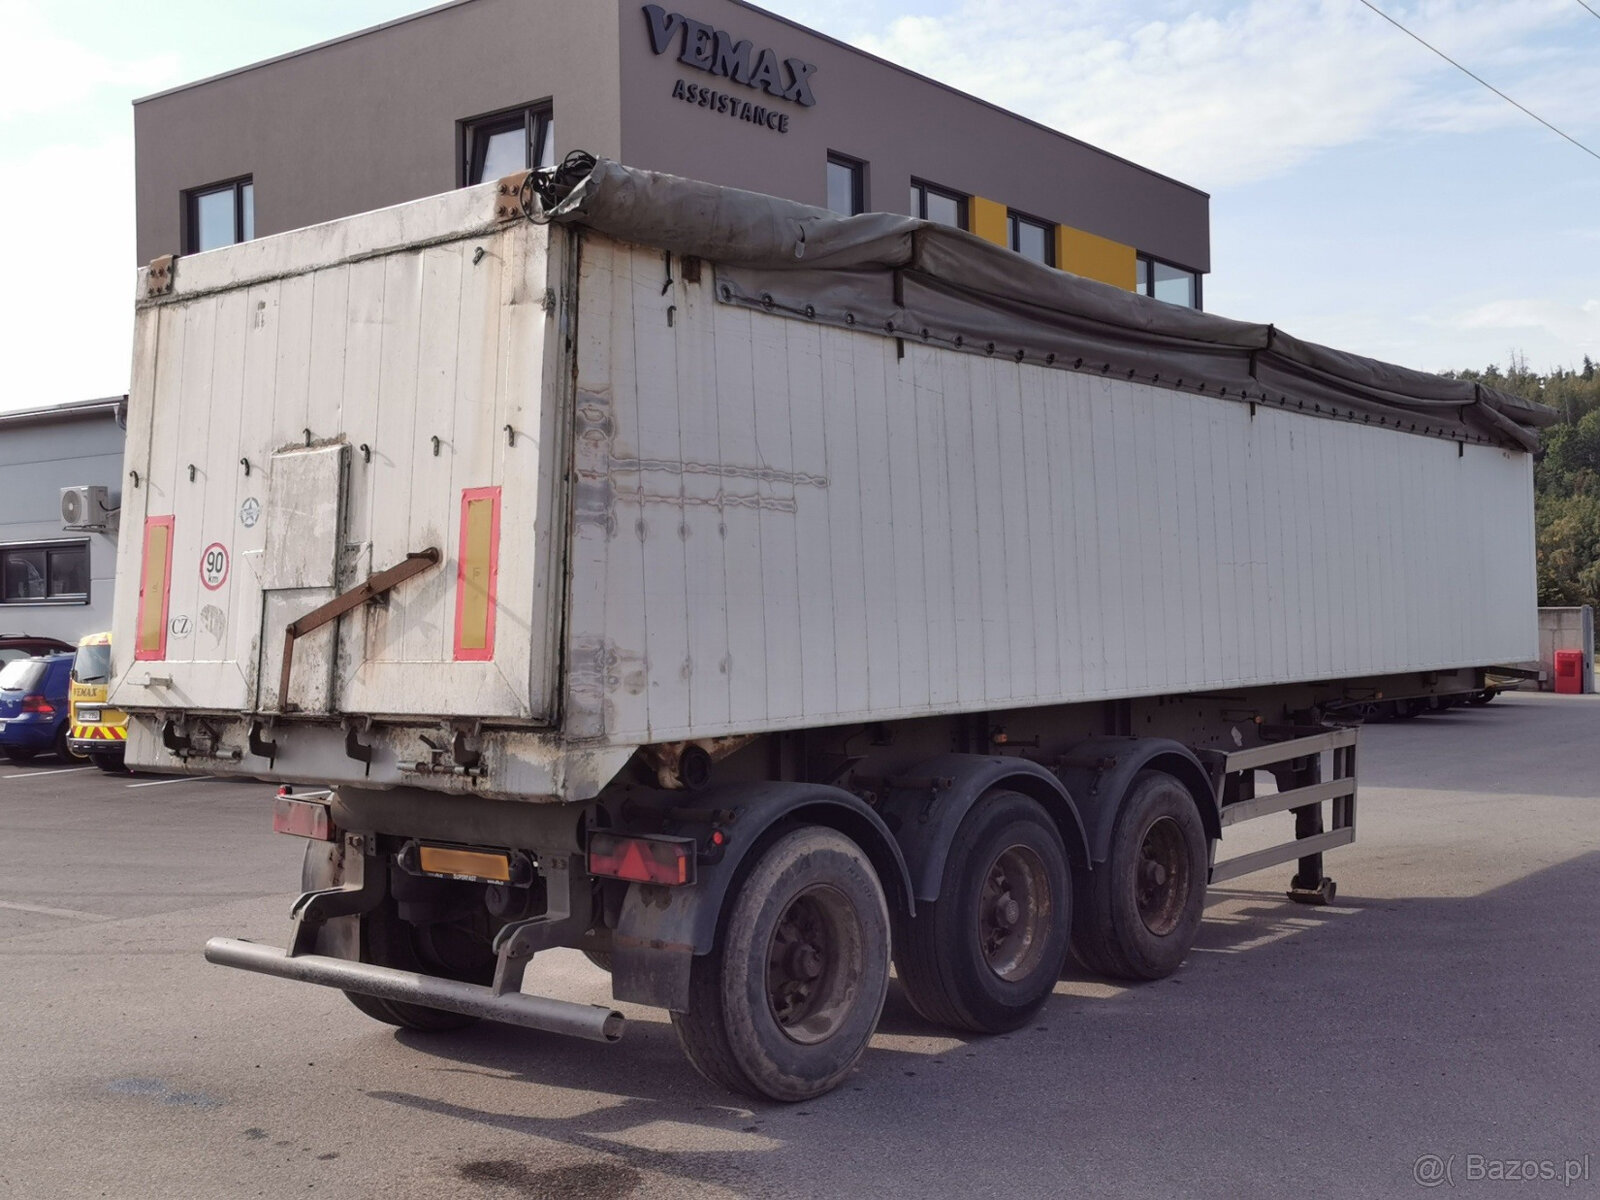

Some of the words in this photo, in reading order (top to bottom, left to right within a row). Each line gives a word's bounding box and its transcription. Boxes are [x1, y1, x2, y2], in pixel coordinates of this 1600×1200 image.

[641, 4, 818, 108] VEMAX
[672, 79, 790, 134] ASSISTANCE
[206, 551, 224, 573] 90
[171, 618, 189, 635] CZ
